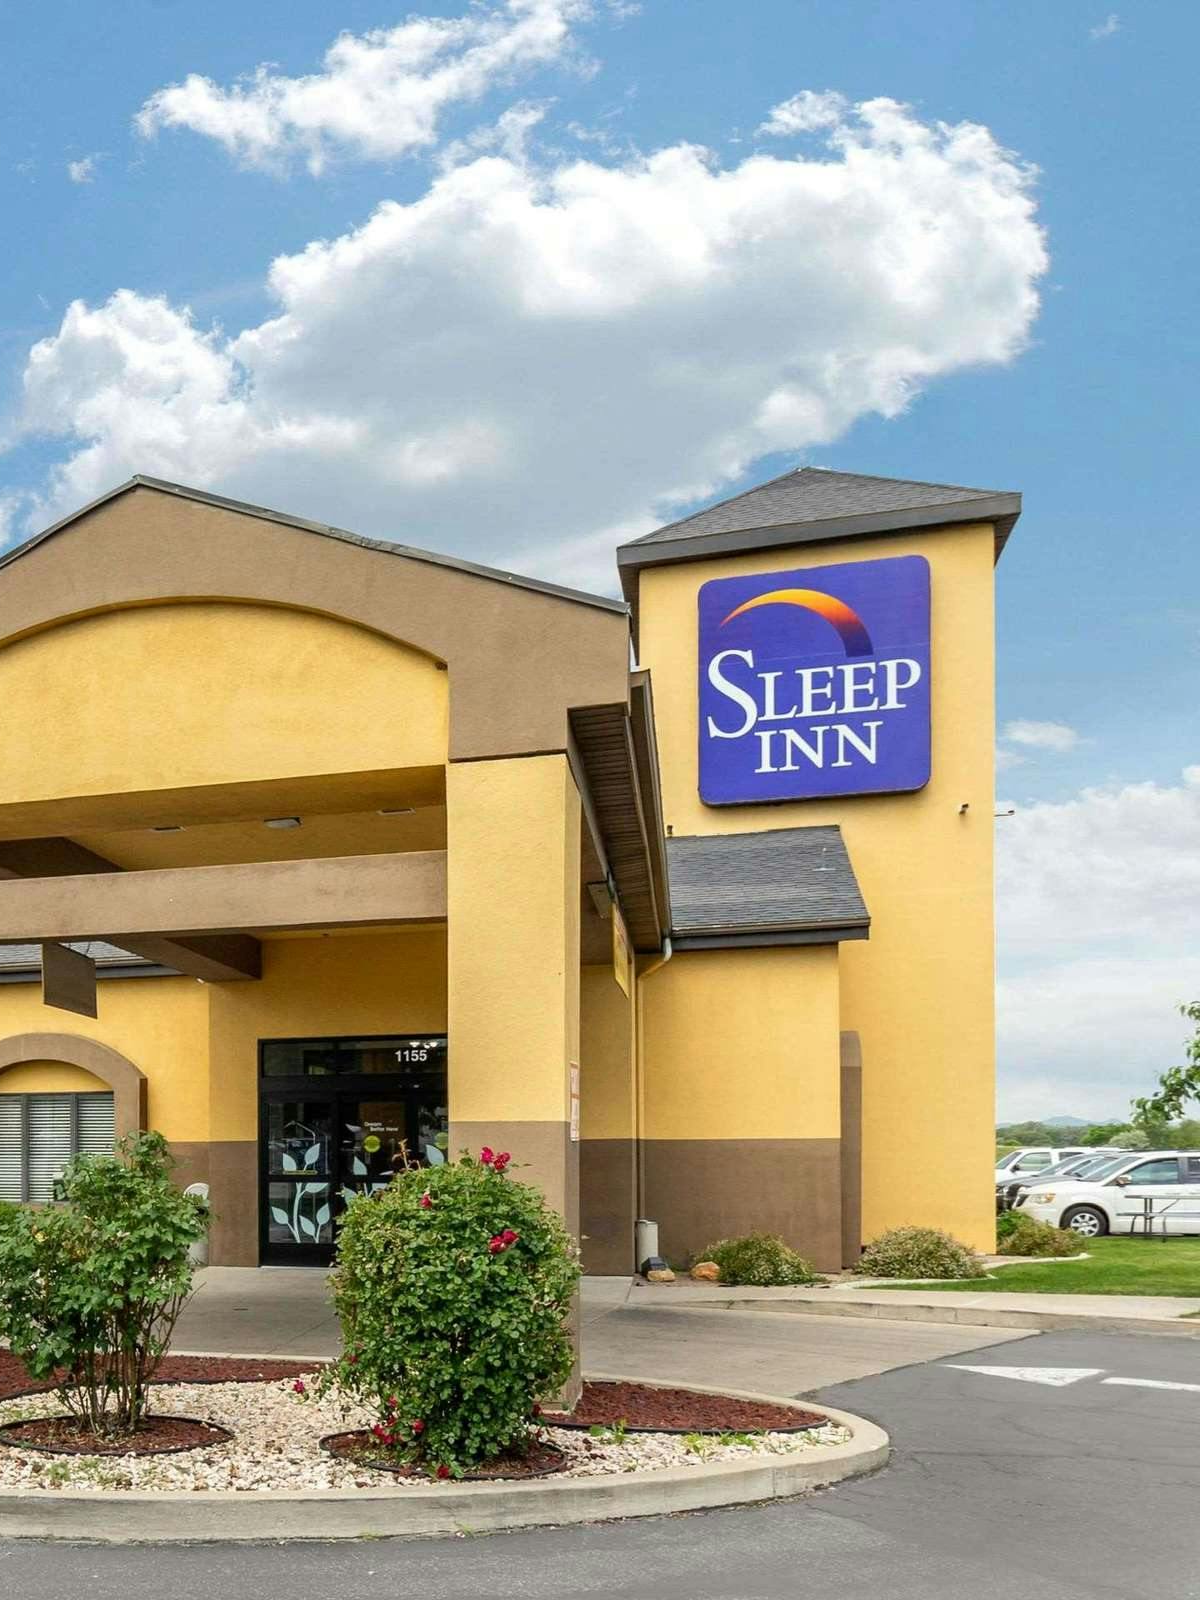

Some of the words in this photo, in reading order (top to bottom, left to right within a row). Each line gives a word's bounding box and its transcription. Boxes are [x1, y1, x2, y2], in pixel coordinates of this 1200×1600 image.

[708, 649, 922, 738] SLEEP
[754, 721, 884, 774] INN
[395, 1050, 428, 1062] 1155
